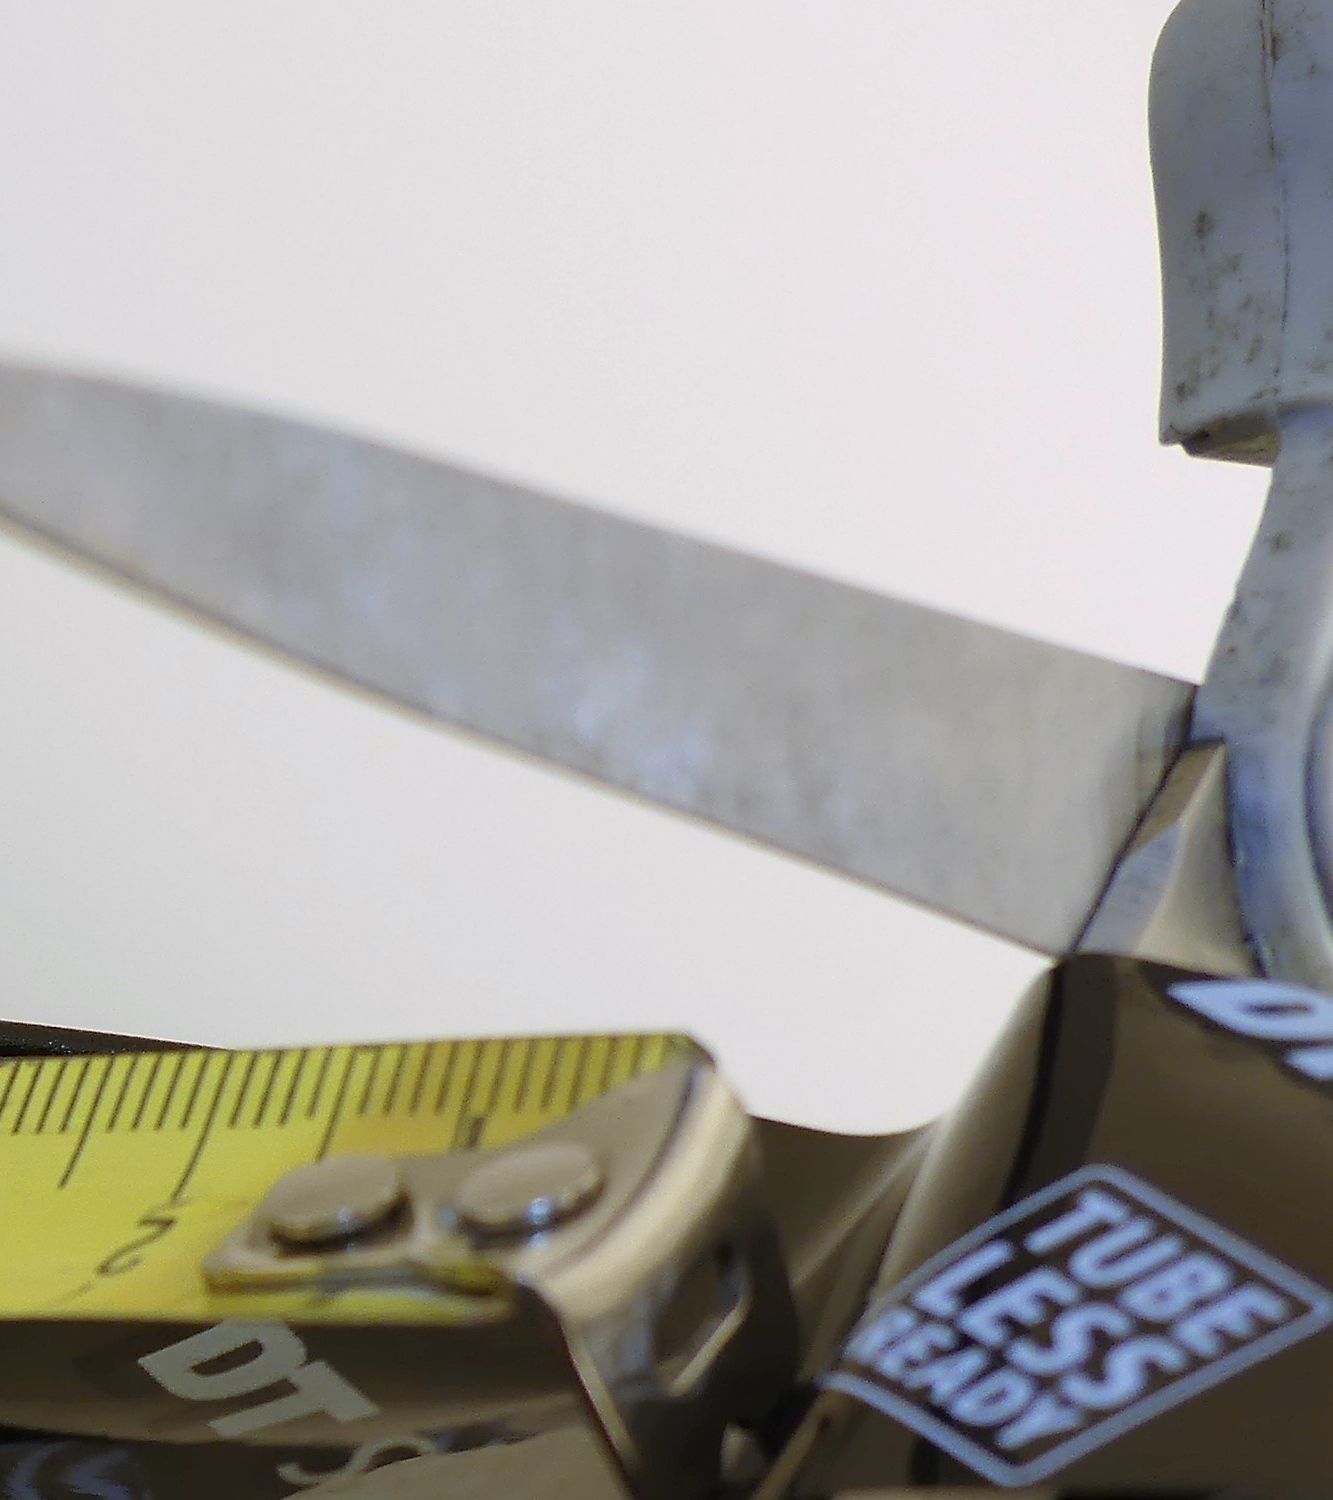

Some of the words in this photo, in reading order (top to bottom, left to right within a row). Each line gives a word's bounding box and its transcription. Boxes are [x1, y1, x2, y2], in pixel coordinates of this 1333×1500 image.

[1166, 980, 1333, 1081] D
[96, 1216, 176, 1276] 2
[1026, 1190, 1285, 1355] TUBE
[136, 1316, 379, 1438] DT
[842, 1305, 1083, 1449] READY
[915, 1238, 1185, 1409] LESS
